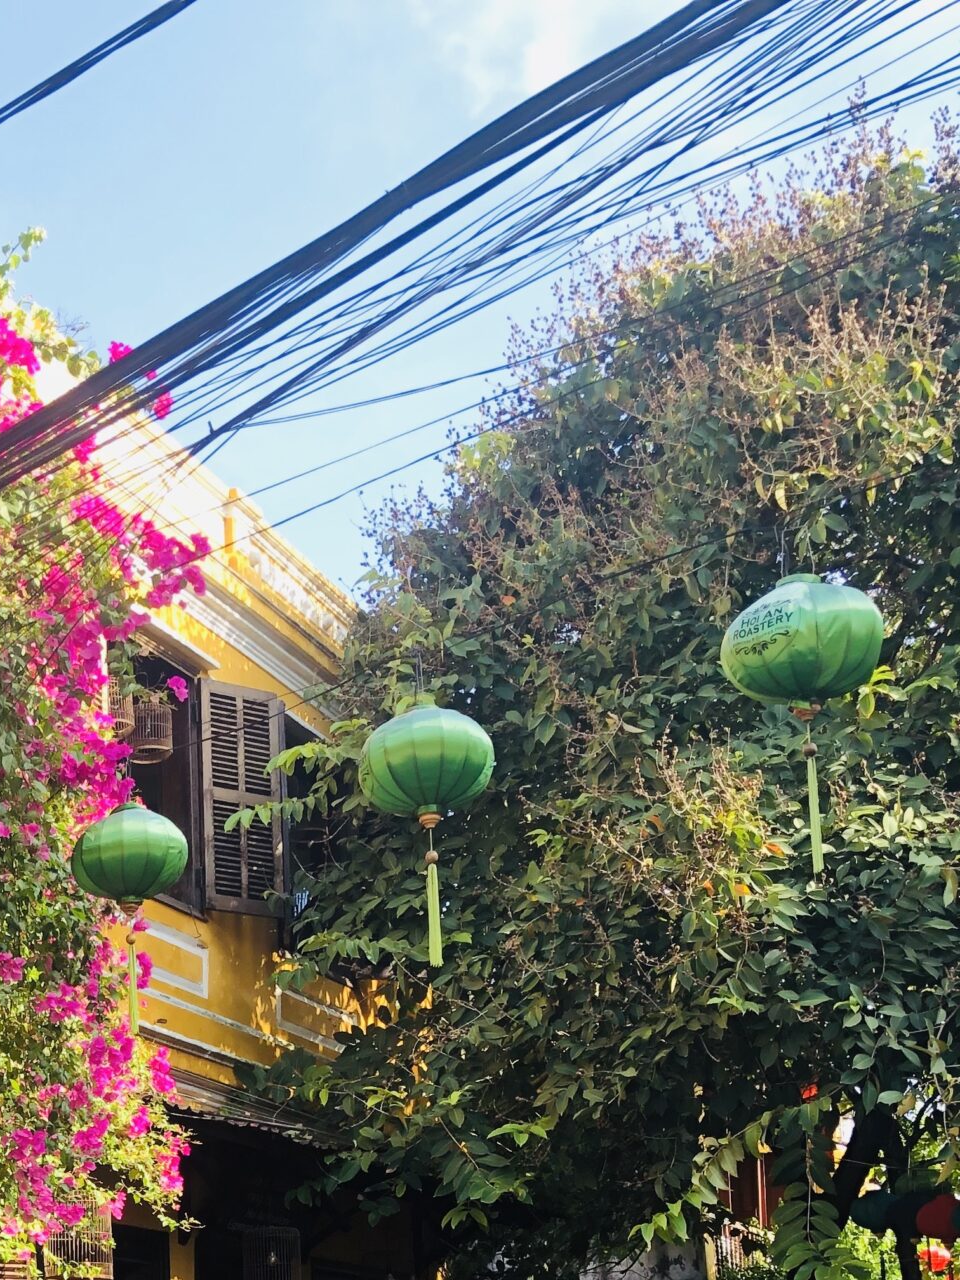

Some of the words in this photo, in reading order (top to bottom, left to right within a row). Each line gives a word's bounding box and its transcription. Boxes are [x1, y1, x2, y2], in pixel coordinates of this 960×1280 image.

[733, 611, 794, 641] ROASTERY
[741, 615, 760, 629] HOI
[762, 607, 783, 621] AN
